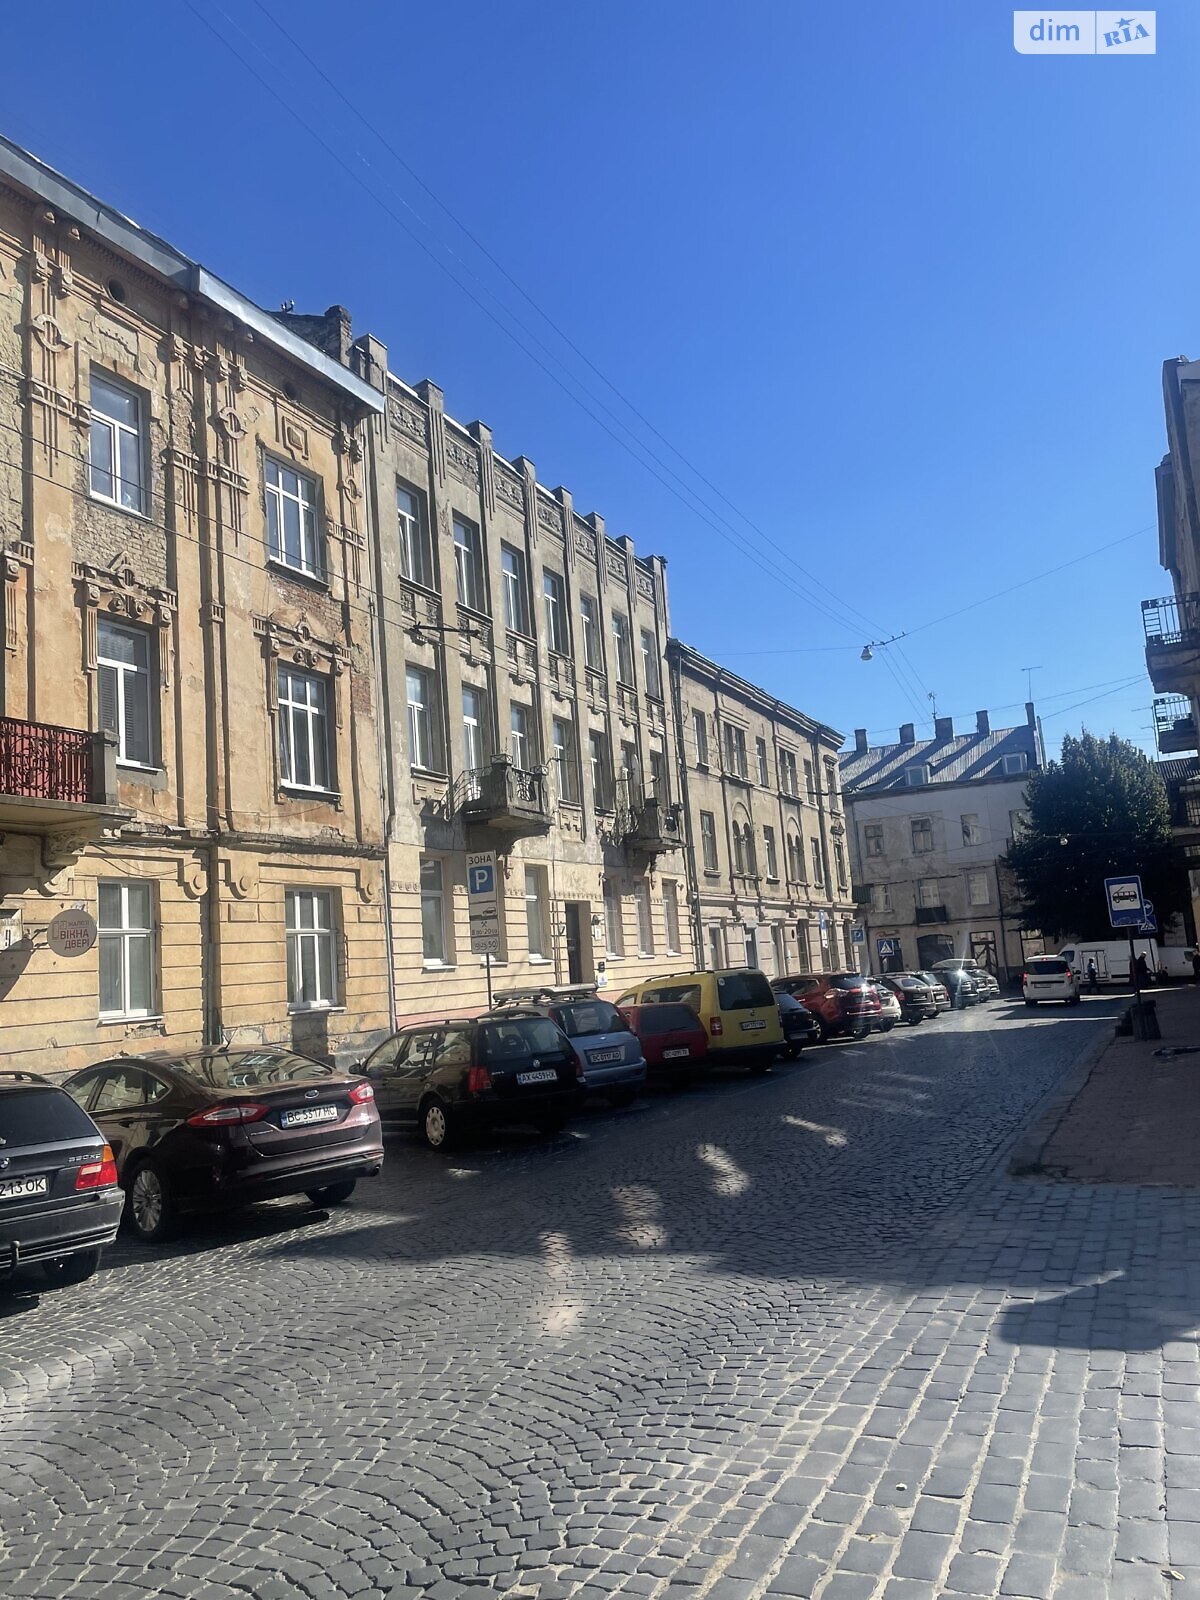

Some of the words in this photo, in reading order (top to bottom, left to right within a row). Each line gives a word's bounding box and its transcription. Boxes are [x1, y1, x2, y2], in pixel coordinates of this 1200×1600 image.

[468, 855, 492, 865] ЗОНА
[475, 869, 488, 890] P
[60, 929, 90, 941] ВІКНА
[65, 939, 91, 950] ДВЕРІ
[287, 1111, 301, 1123] BC
[25, 1177, 45, 1192] OK
